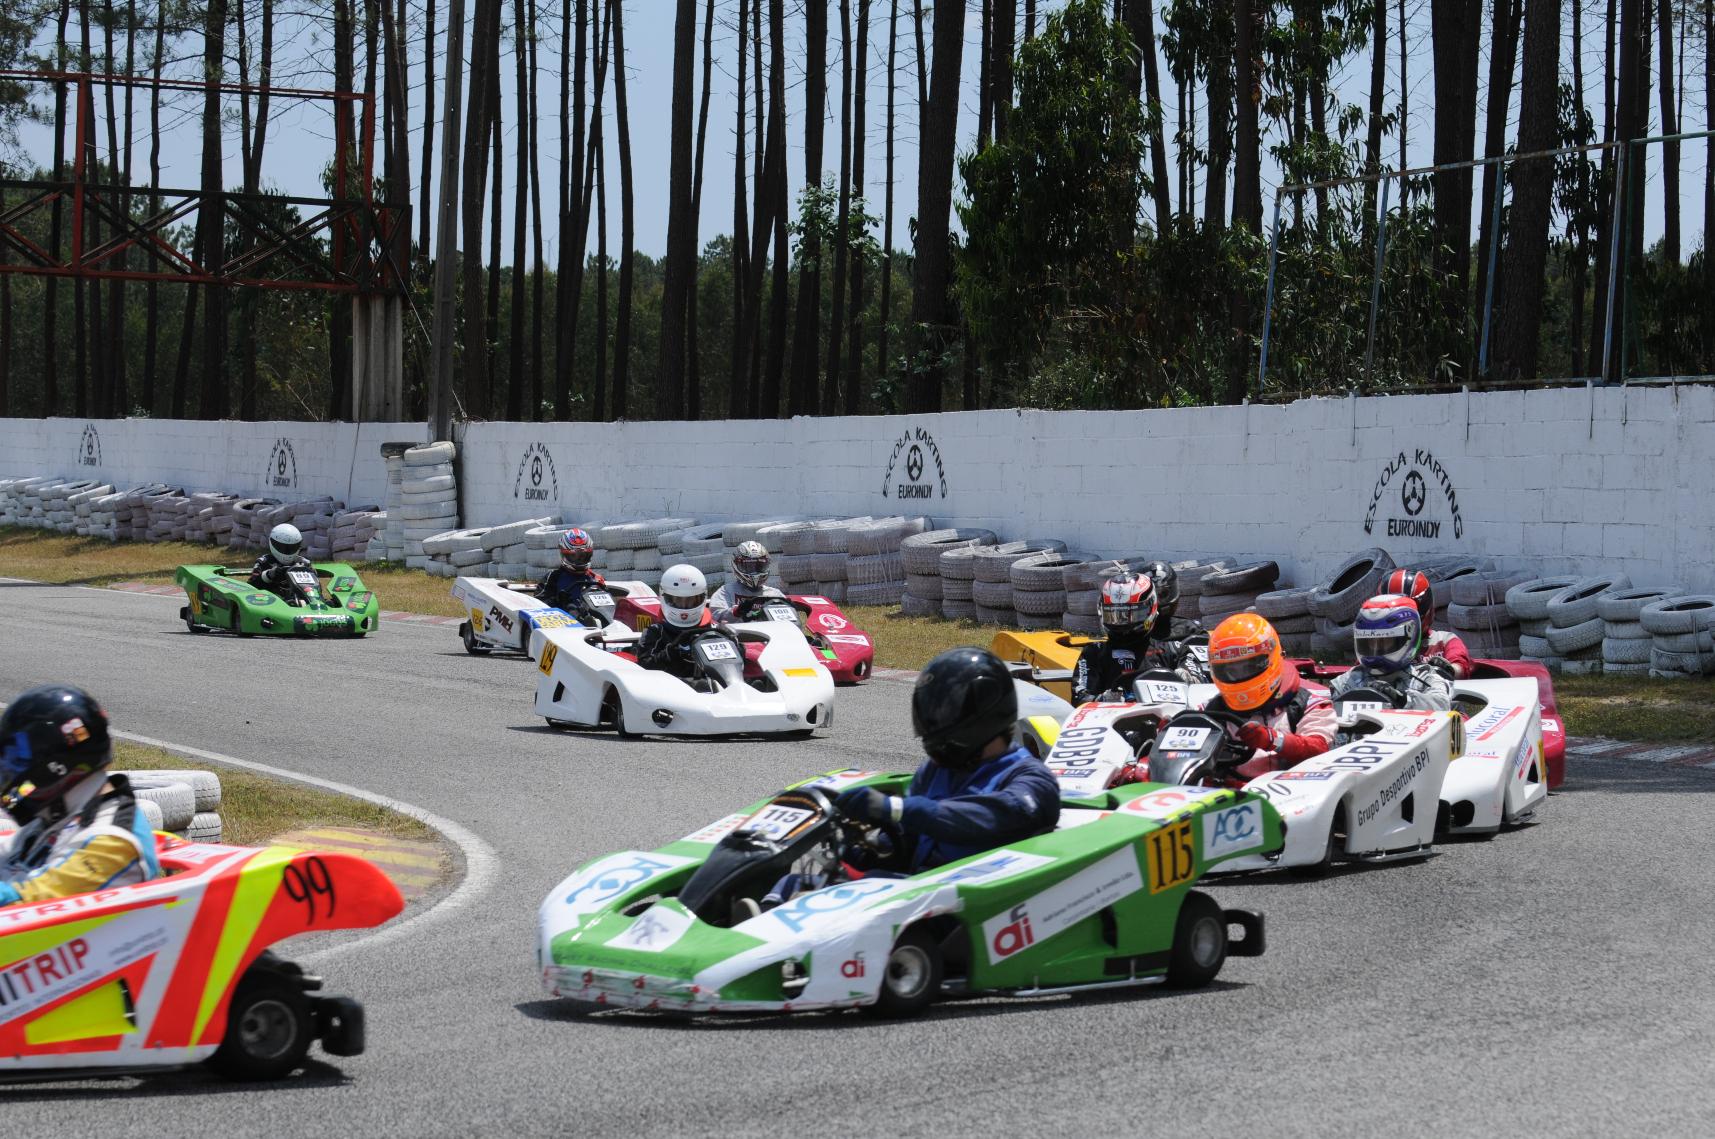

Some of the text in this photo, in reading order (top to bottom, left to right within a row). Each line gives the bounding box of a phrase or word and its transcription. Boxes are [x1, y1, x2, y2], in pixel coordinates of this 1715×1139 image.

[883, 426, 947, 499] ESCOLA KARTING
[898, 484, 932, 499] EUROINDY
[1364, 449, 1463, 539] ESCOLA KARTING
[1387, 518, 1440, 538] EUROINDY
[490, 604, 514, 633] PMH
[707, 641, 727, 651] 129
[1155, 684, 1178, 692] 125
[1177, 729, 1199, 737] 90
[1357, 747, 1431, 827] Grupo Desportivo BPI
[764, 808, 802, 823] 115
[1152, 826, 1193, 890] 115
[283, 856, 336, 926] 99
